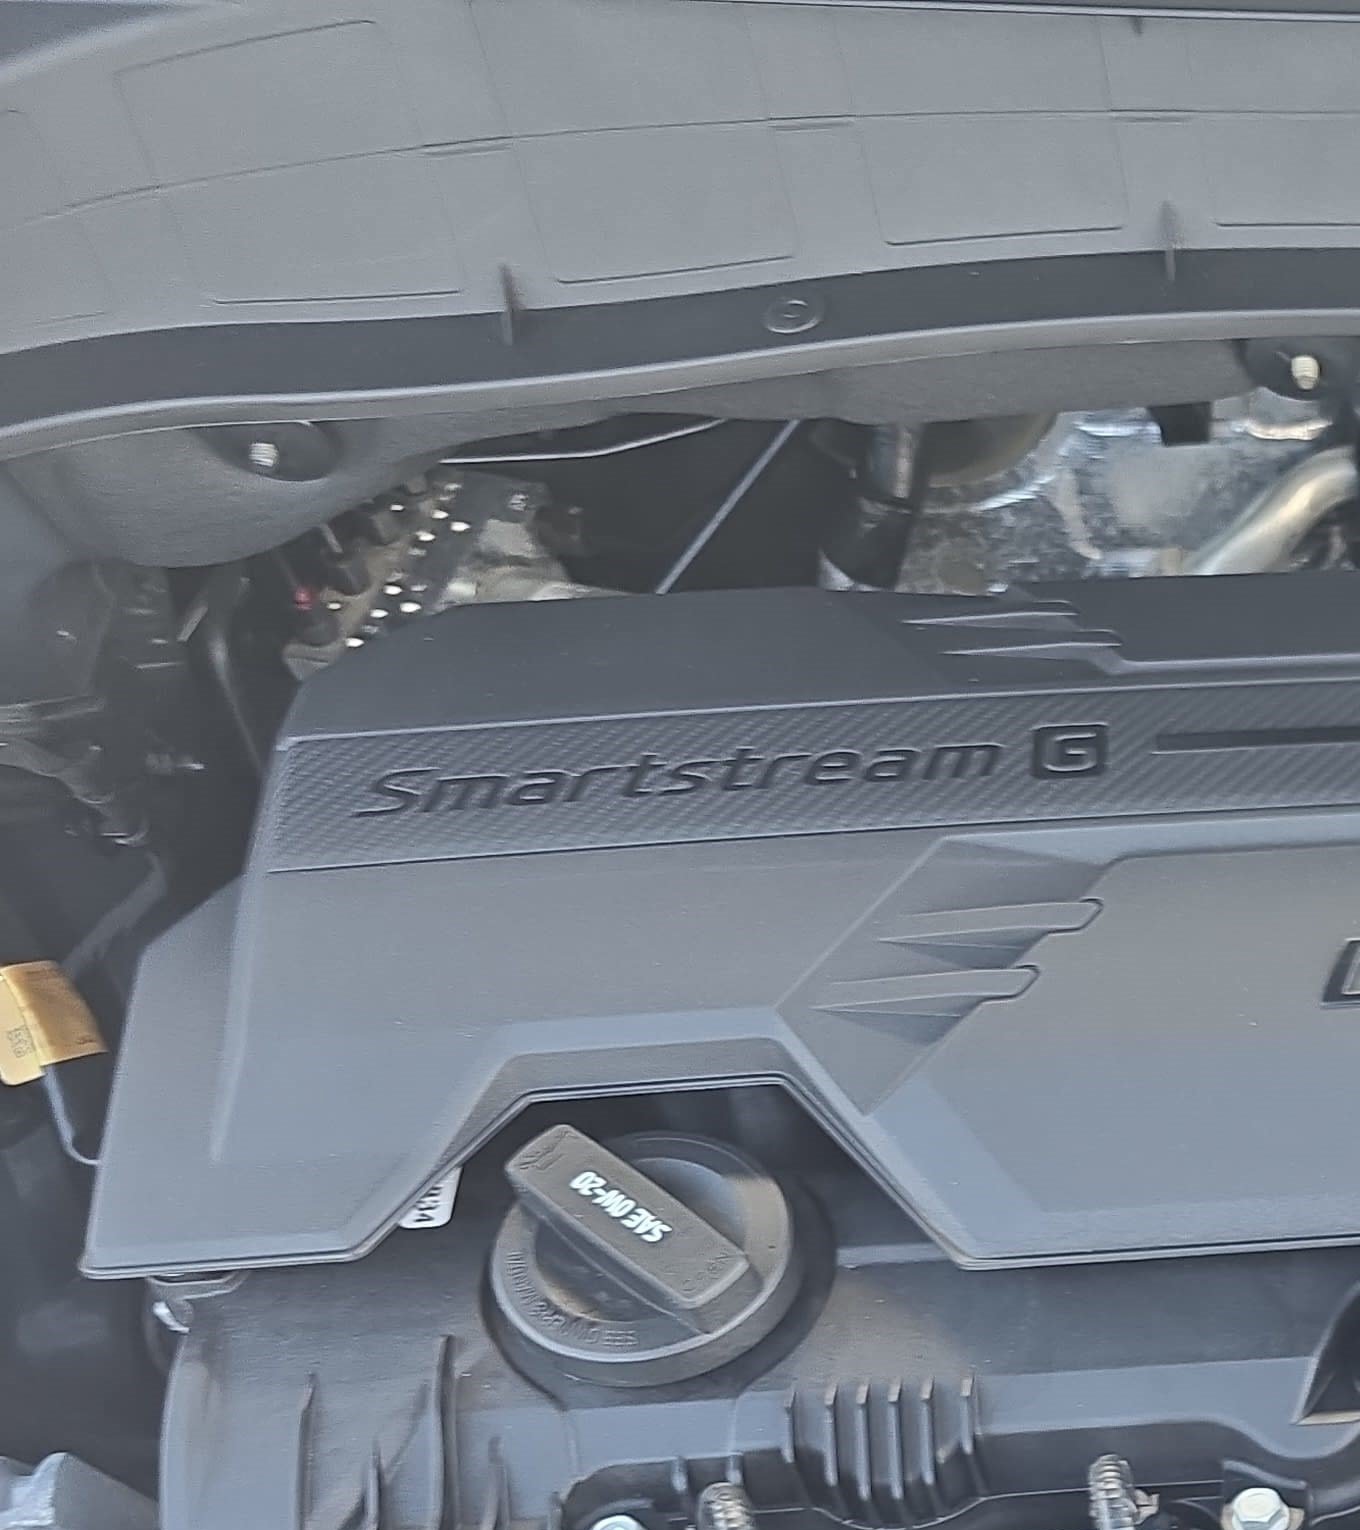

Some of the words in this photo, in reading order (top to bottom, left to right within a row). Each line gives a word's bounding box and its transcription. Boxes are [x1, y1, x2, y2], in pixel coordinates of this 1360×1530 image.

[352, 743, 1006, 818] Smartstream
[569, 1170, 639, 1218] 0W-20
[621, 1207, 673, 1243] SAE
